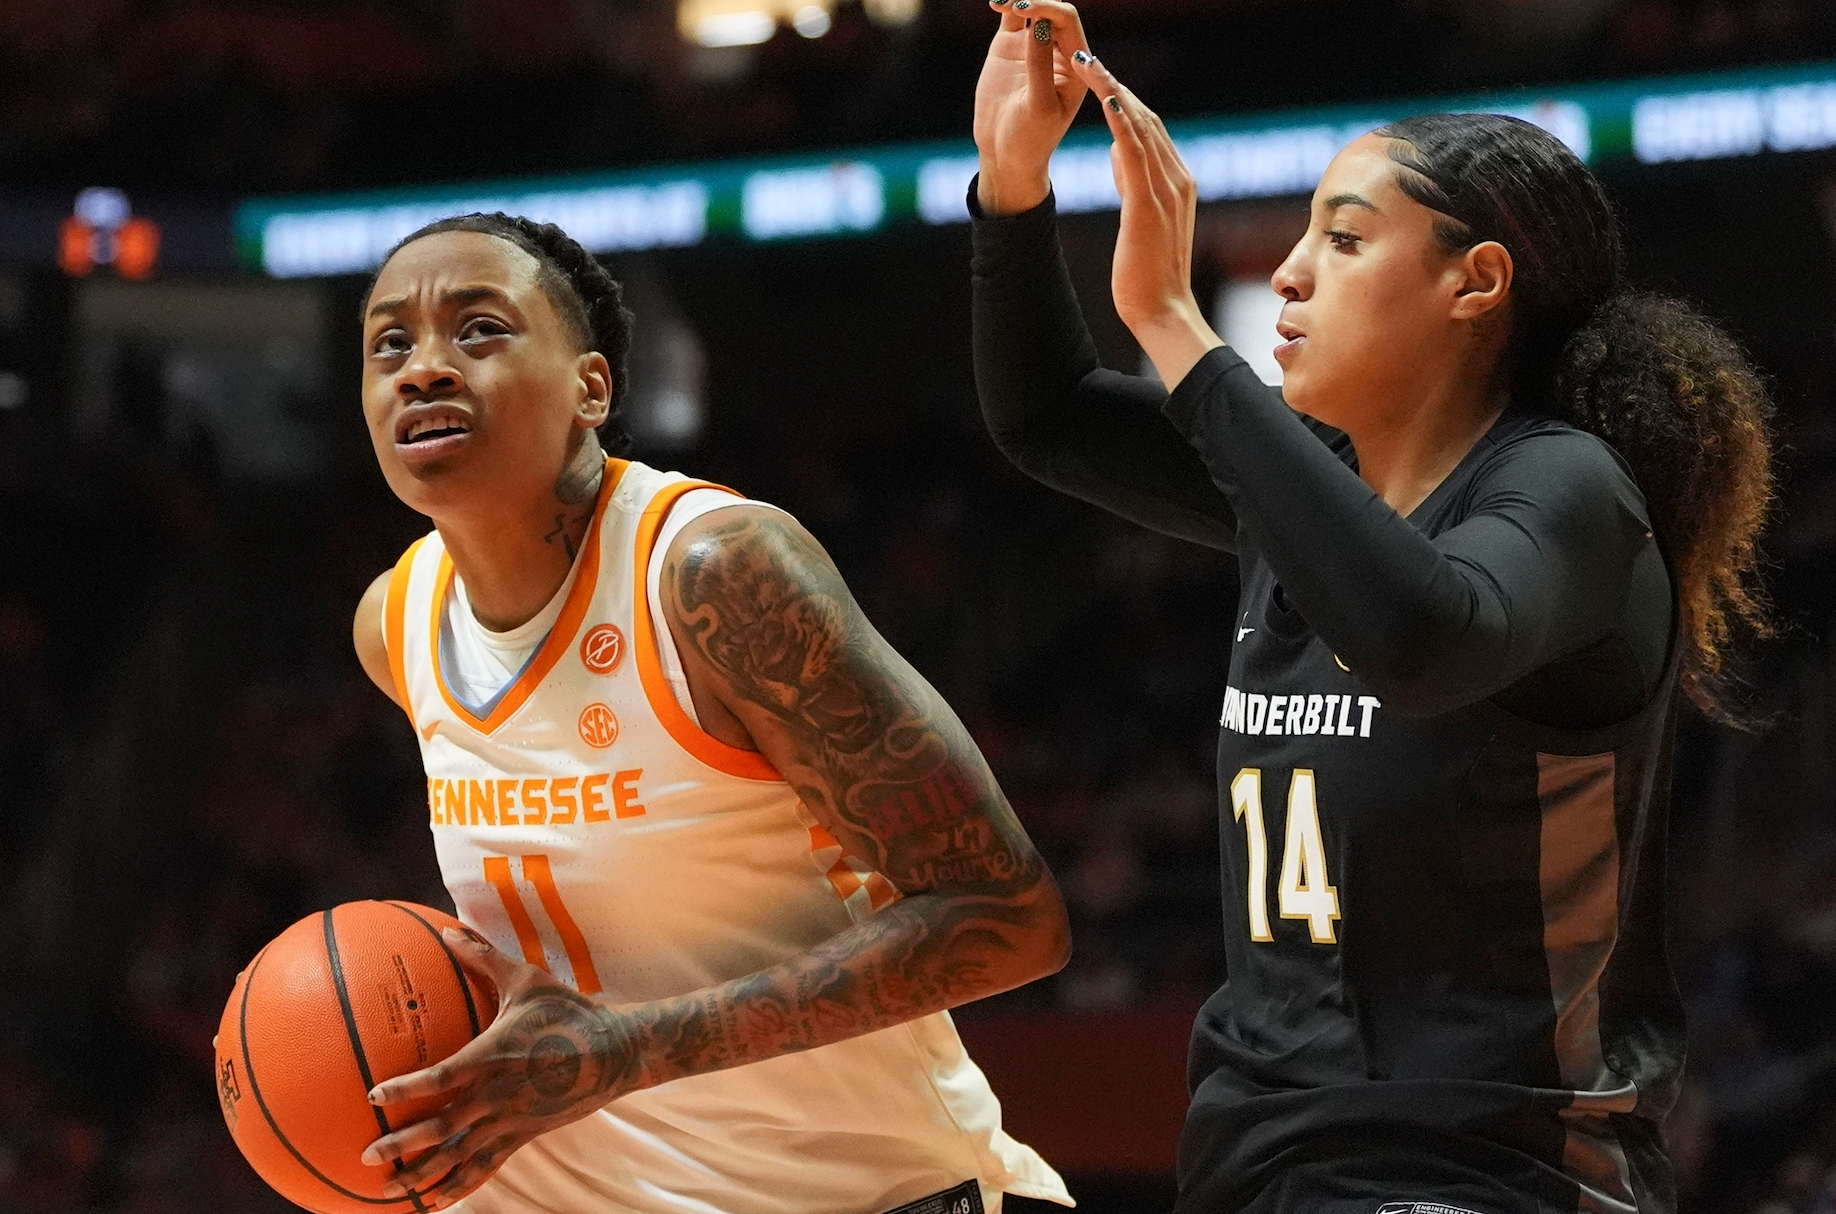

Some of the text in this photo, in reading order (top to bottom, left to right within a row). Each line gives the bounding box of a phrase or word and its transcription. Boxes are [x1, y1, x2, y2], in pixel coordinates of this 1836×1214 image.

[580, 705, 617, 748] SEC
[1219, 685, 1381, 738] VANDERBILT
[1230, 768, 1341, 944] 14
[483, 855, 602, 993] 11
[952, 1197, 970, 1214] 48
